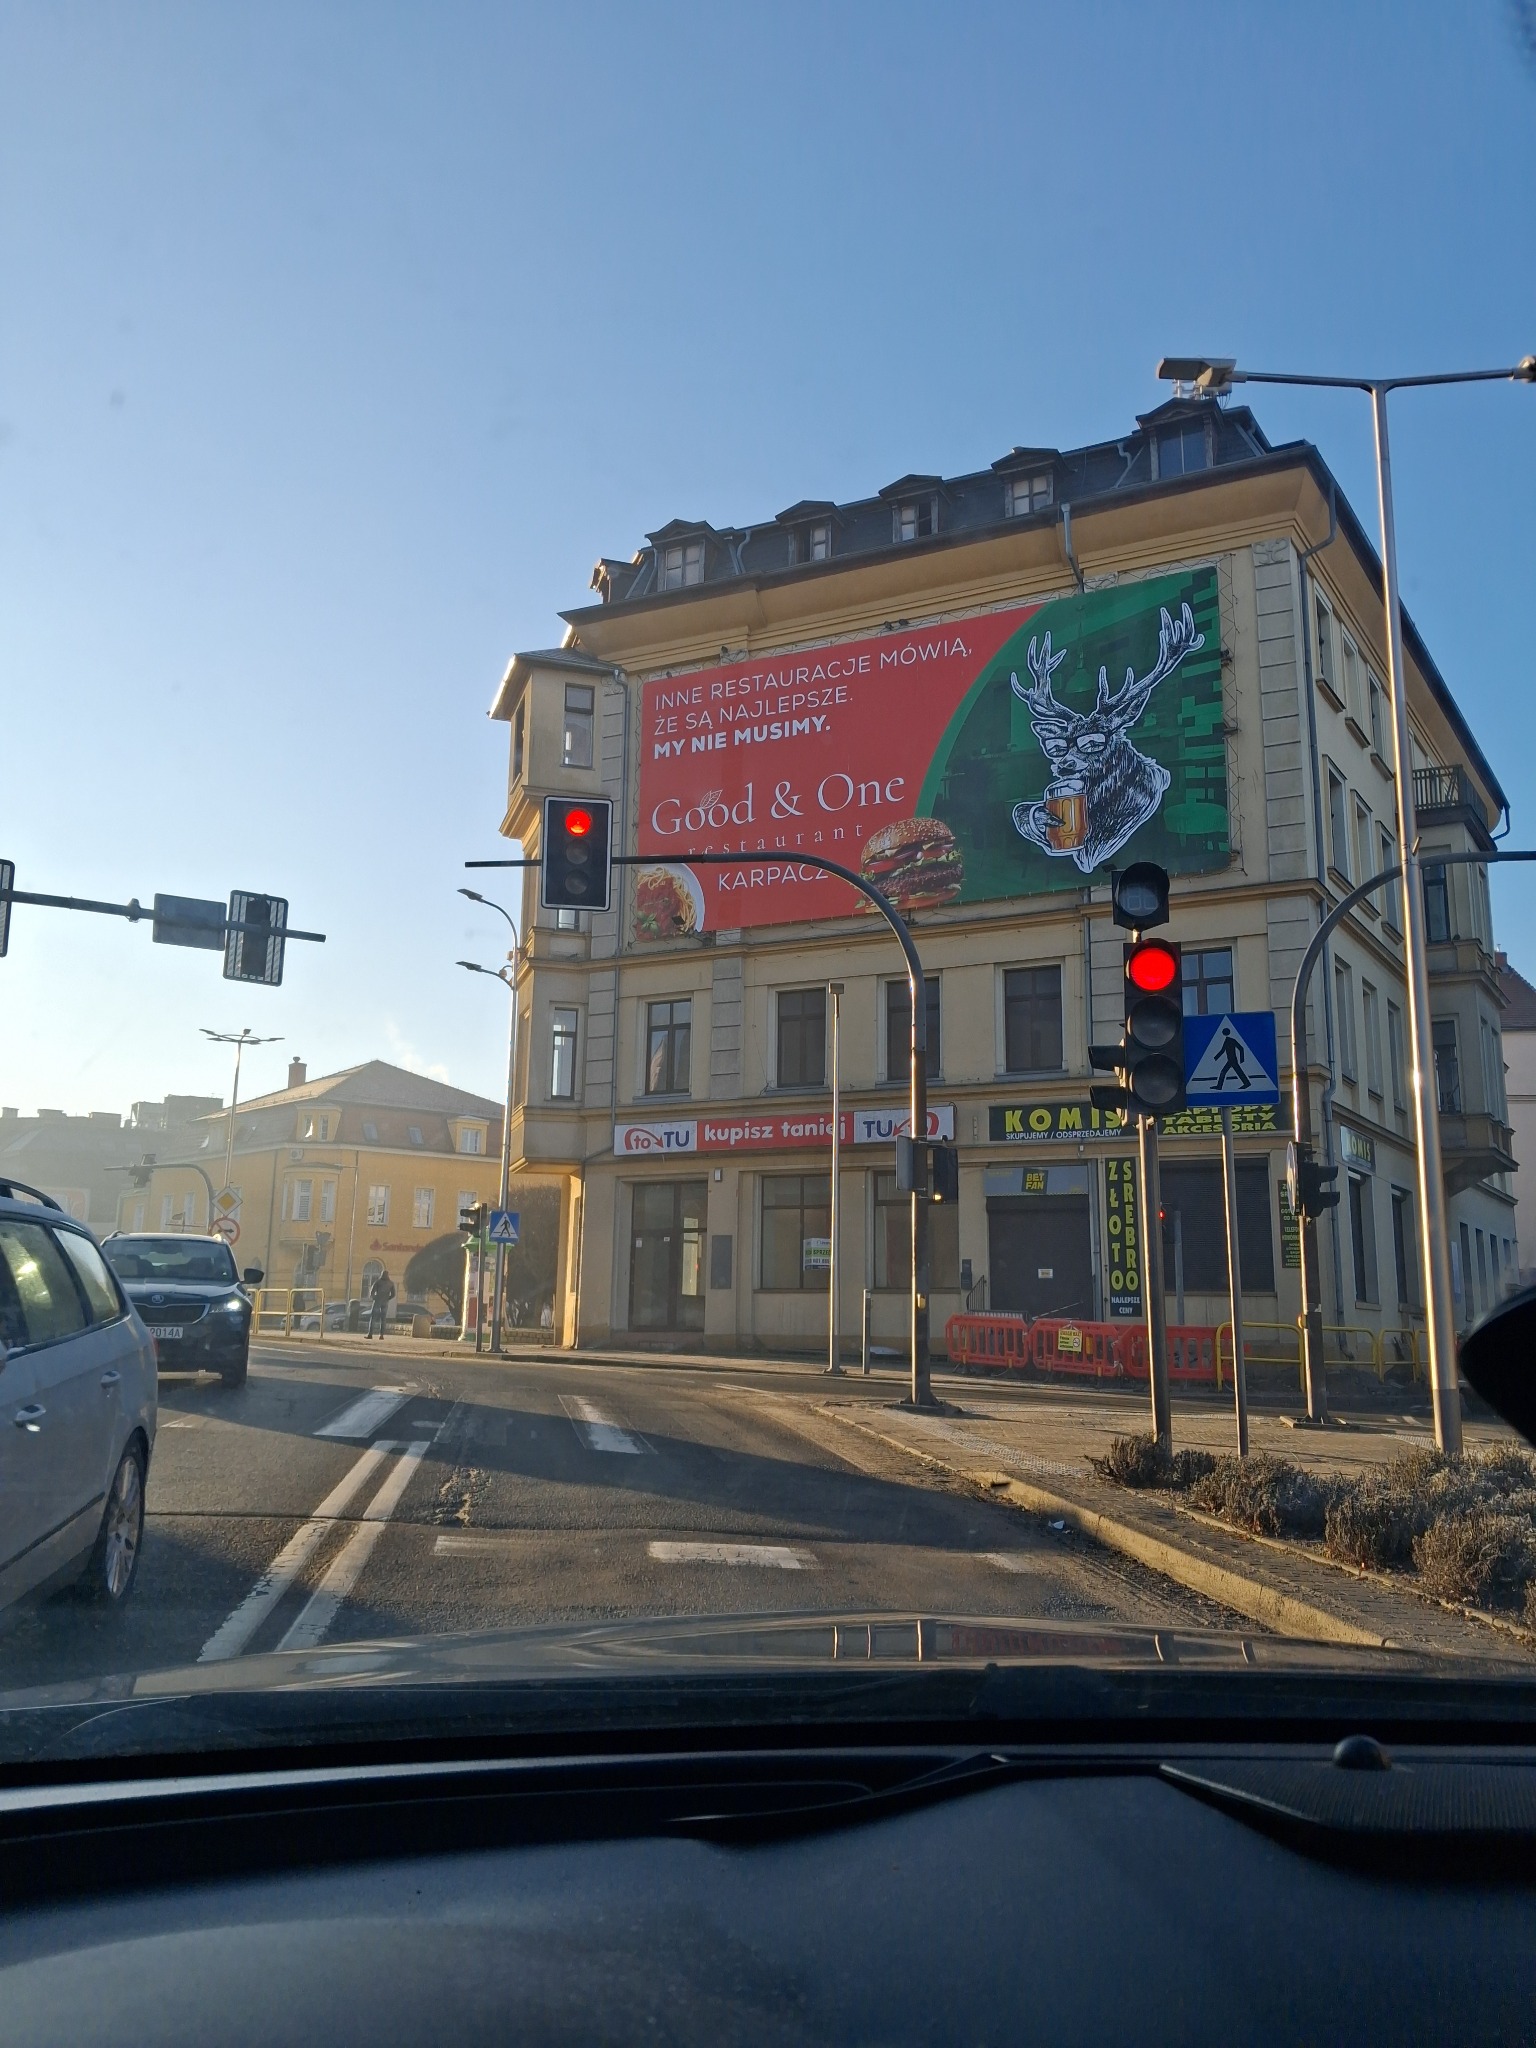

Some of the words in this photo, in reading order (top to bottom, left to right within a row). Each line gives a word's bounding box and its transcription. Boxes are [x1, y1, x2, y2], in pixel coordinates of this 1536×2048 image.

[655, 686, 703, 711] INNE
[711, 655, 871, 700] RESTAURACJE
[880, 637, 972, 669] MÓWIĄ,
[654, 715, 678, 736] ŻE
[685, 710, 714, 730] SĄ
[719, 685, 853, 724] NAJLEPSZE.
[654, 739, 686, 760] MY
[691, 731, 727, 753] NIE
[734, 714, 831, 746] MUSIMY.
[651, 782, 756, 836] Good
[770, 781, 805, 820] &
[816, 773, 905, 812] One
[687, 824, 863, 855] restaurant
[718, 863, 829, 892] KARPACZ
[704, 1121, 774, 1146] kupisz
[781, 1116, 846, 1140] taniej
[862, 1119, 893, 1139] TU
[1004, 1107, 1122, 1133] KOMIS
[1005, 1131, 1049, 1140] SKUPUJEMY
[1055, 1128, 1122, 1139] ODSPRZEDAJEMY
[1162, 1121, 1277, 1134] AKCESORIA
[1025, 1181, 1044, 1190] FAN
[1026, 1172, 1045, 1182] BET
[1108, 1161, 1124, 1291] ZŁOTO
[1122, 1160, 1139, 1291] SREBRO
